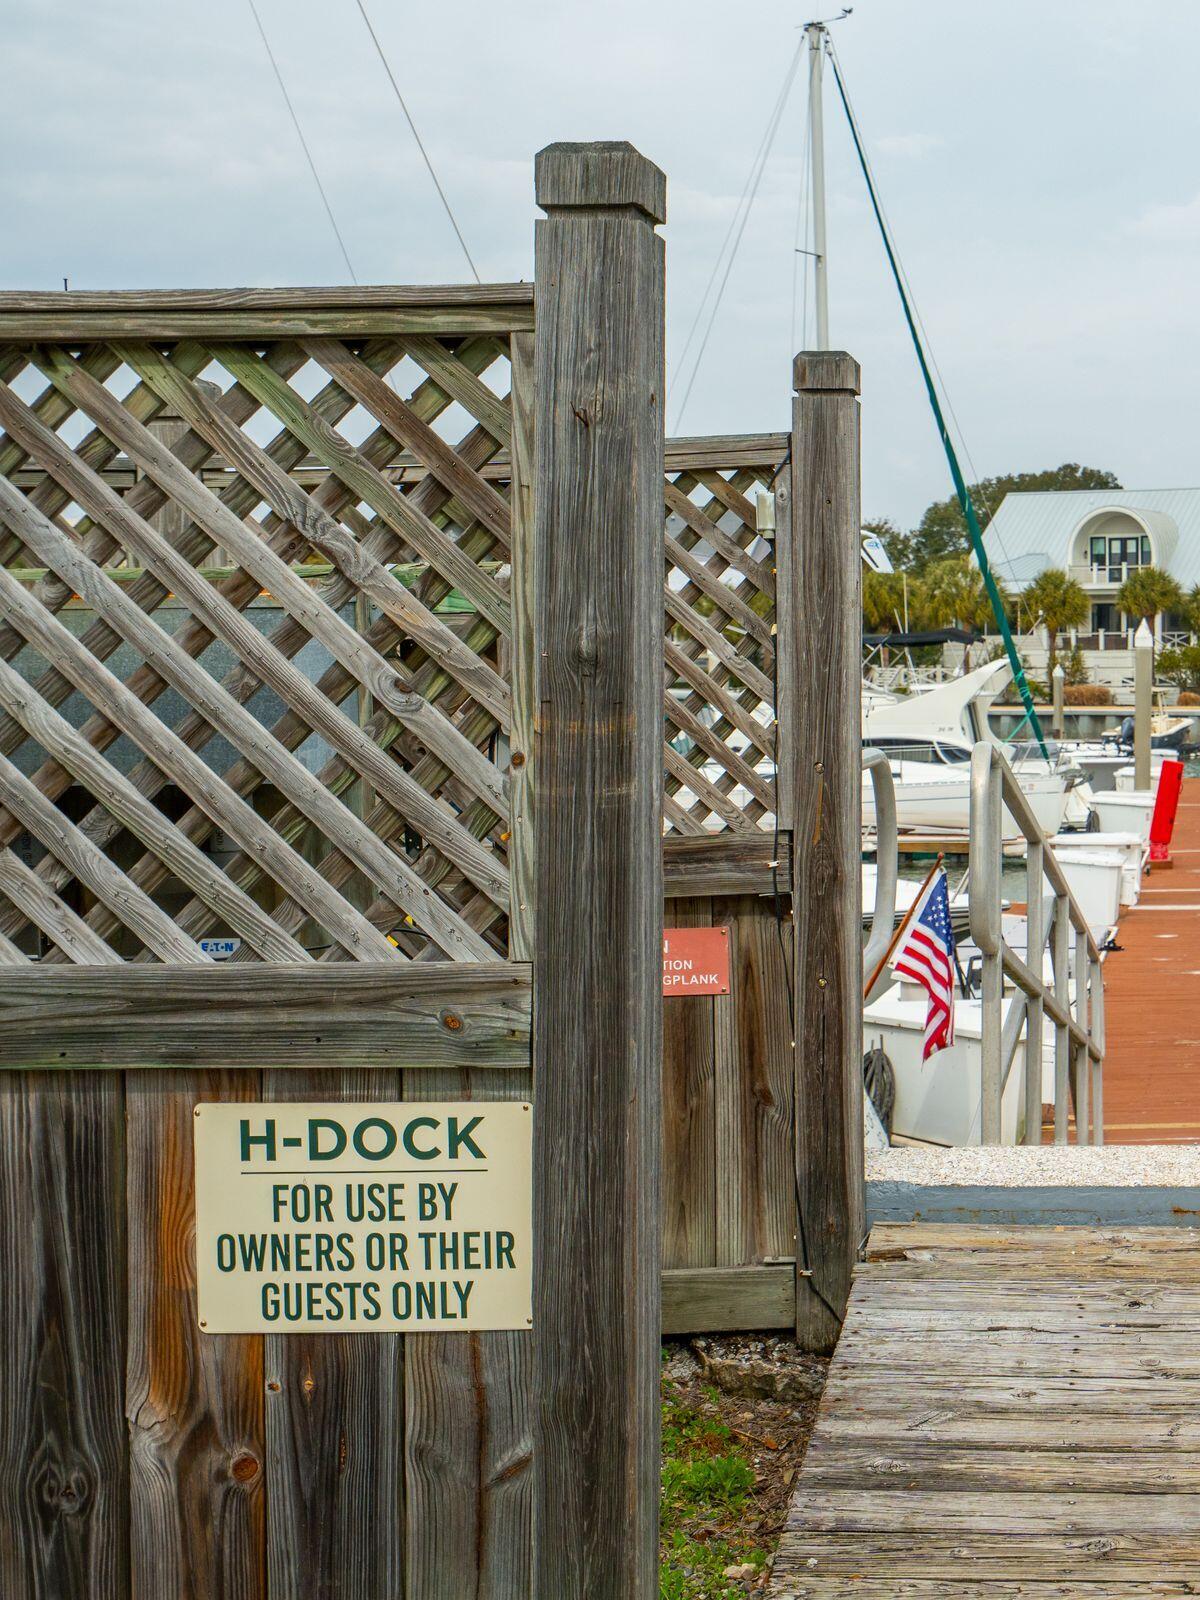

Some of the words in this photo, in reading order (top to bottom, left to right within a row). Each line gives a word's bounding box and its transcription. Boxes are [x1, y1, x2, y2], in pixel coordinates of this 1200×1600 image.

[240, 1116, 487, 1161] H-DOCK
[272, 1183, 334, 1223] FOR
[346, 1183, 405, 1221] USE
[418, 1182, 458, 1221] BY
[217, 1232, 354, 1272] OWNERS
[366, 1232, 410, 1271] OR
[418, 1231, 516, 1270] THEIR
[261, 1282, 382, 1321] GUESTS
[392, 1280, 474, 1319] ONLY
